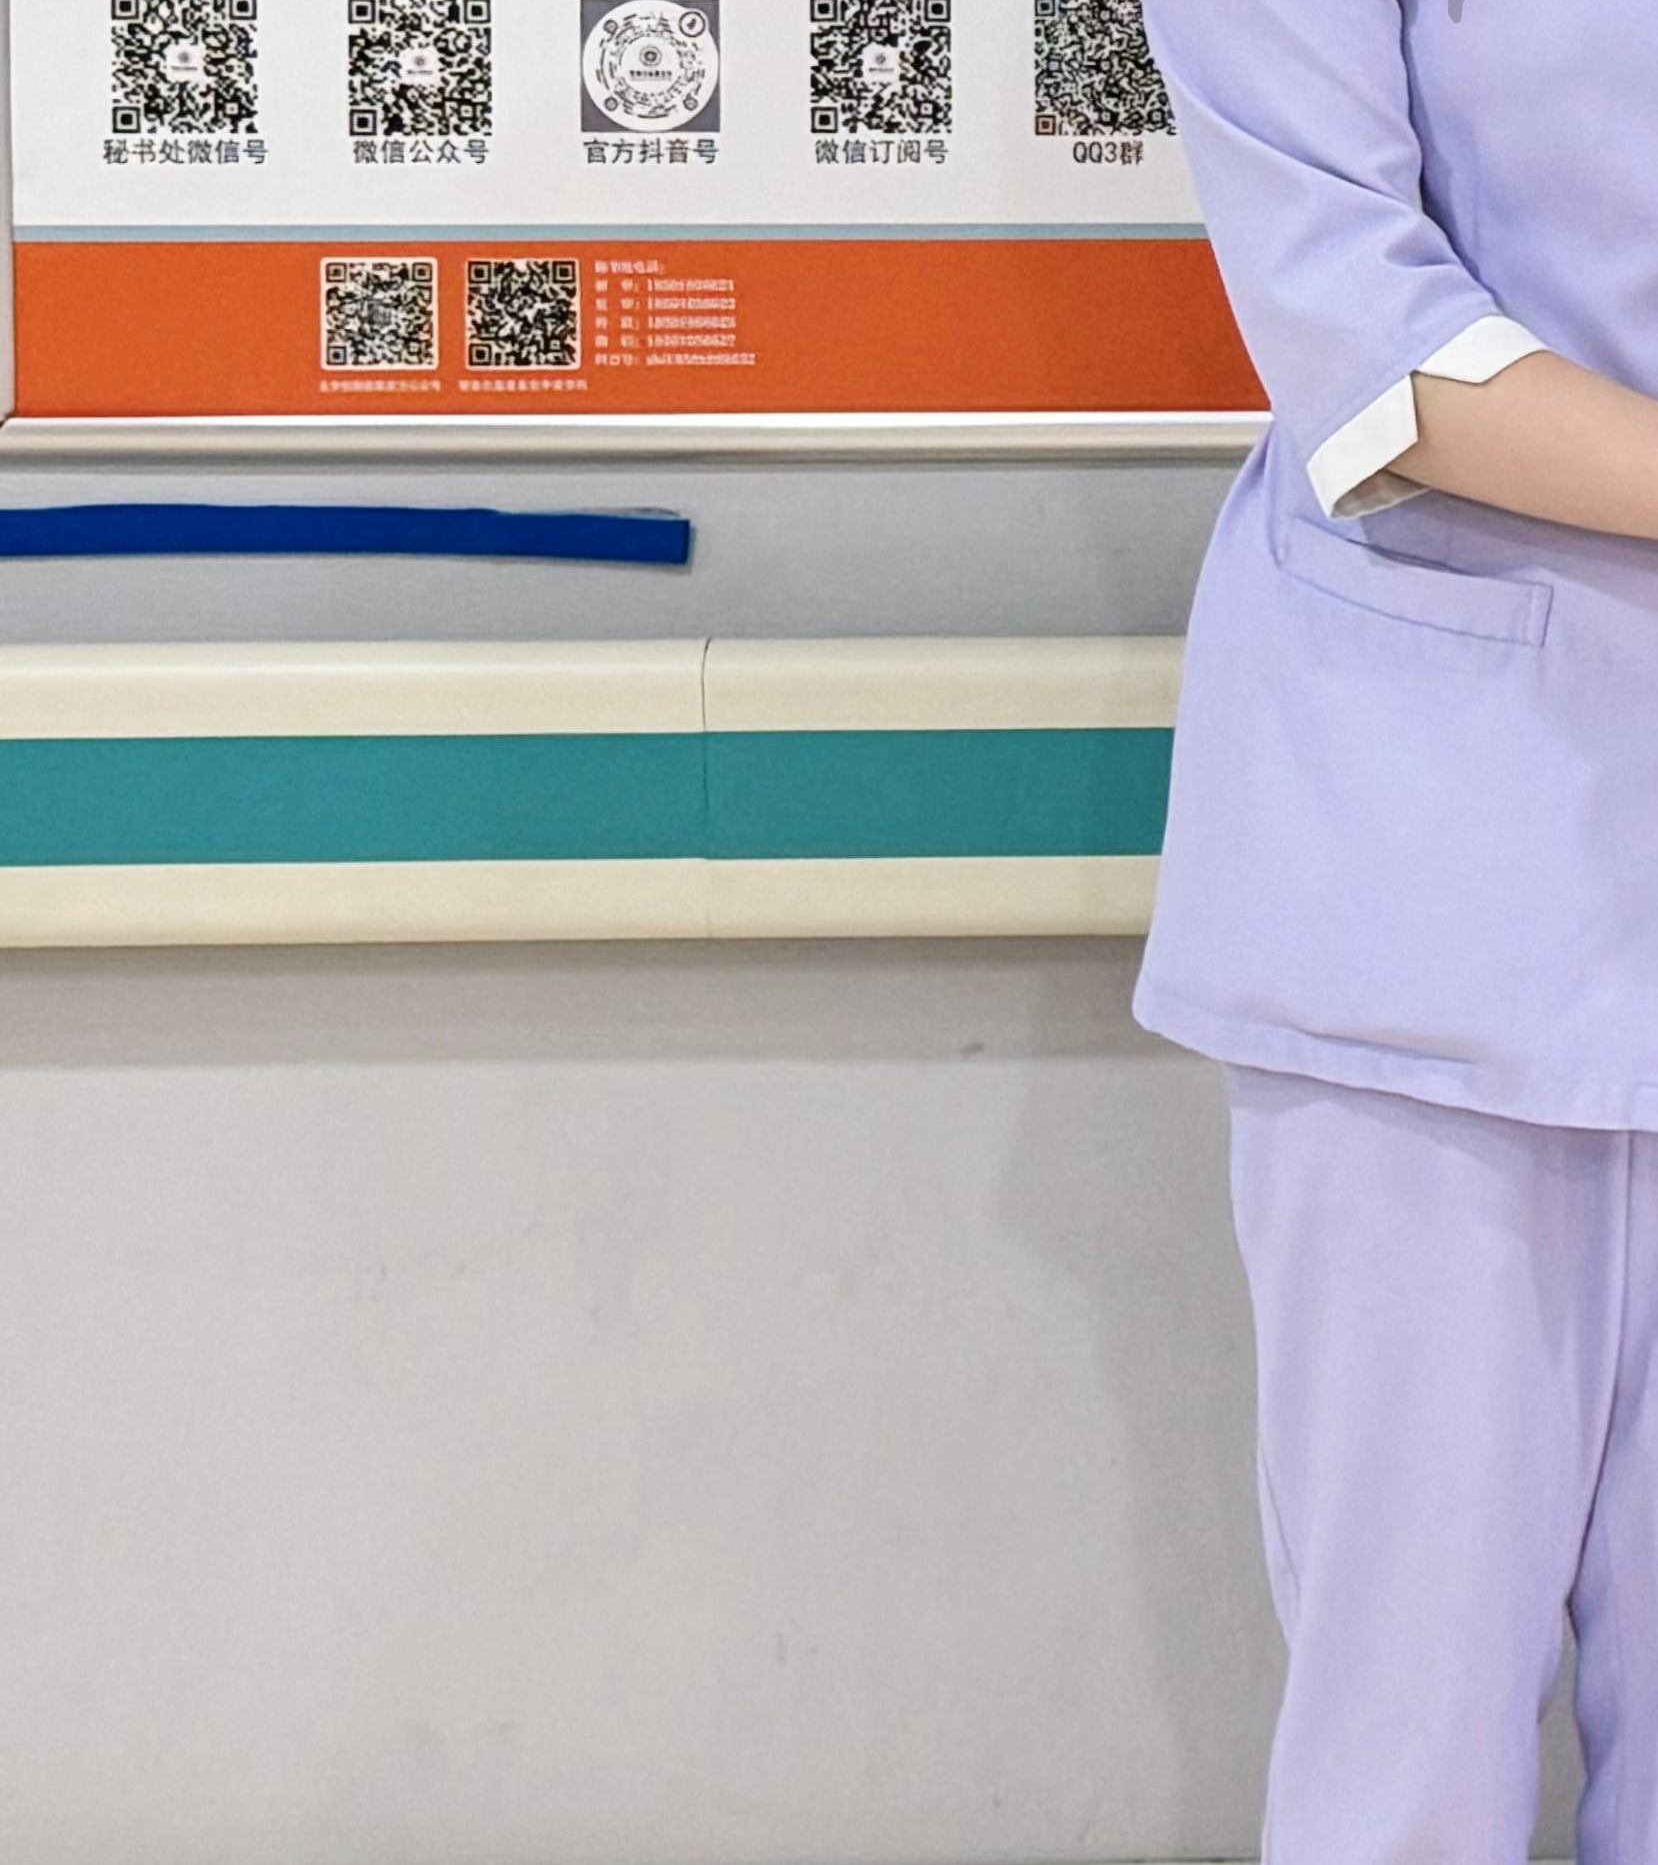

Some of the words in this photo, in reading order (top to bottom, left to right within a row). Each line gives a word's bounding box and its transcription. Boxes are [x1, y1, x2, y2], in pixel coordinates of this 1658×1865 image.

[103, 139, 269, 165] 秘书处微信号
[353, 139, 490, 165] 微信公众号
[584, 139, 720, 165] 官方抖音号
[814, 139, 949, 165] 微信订阅号
[1072, 139, 1145, 165] QQ3群
